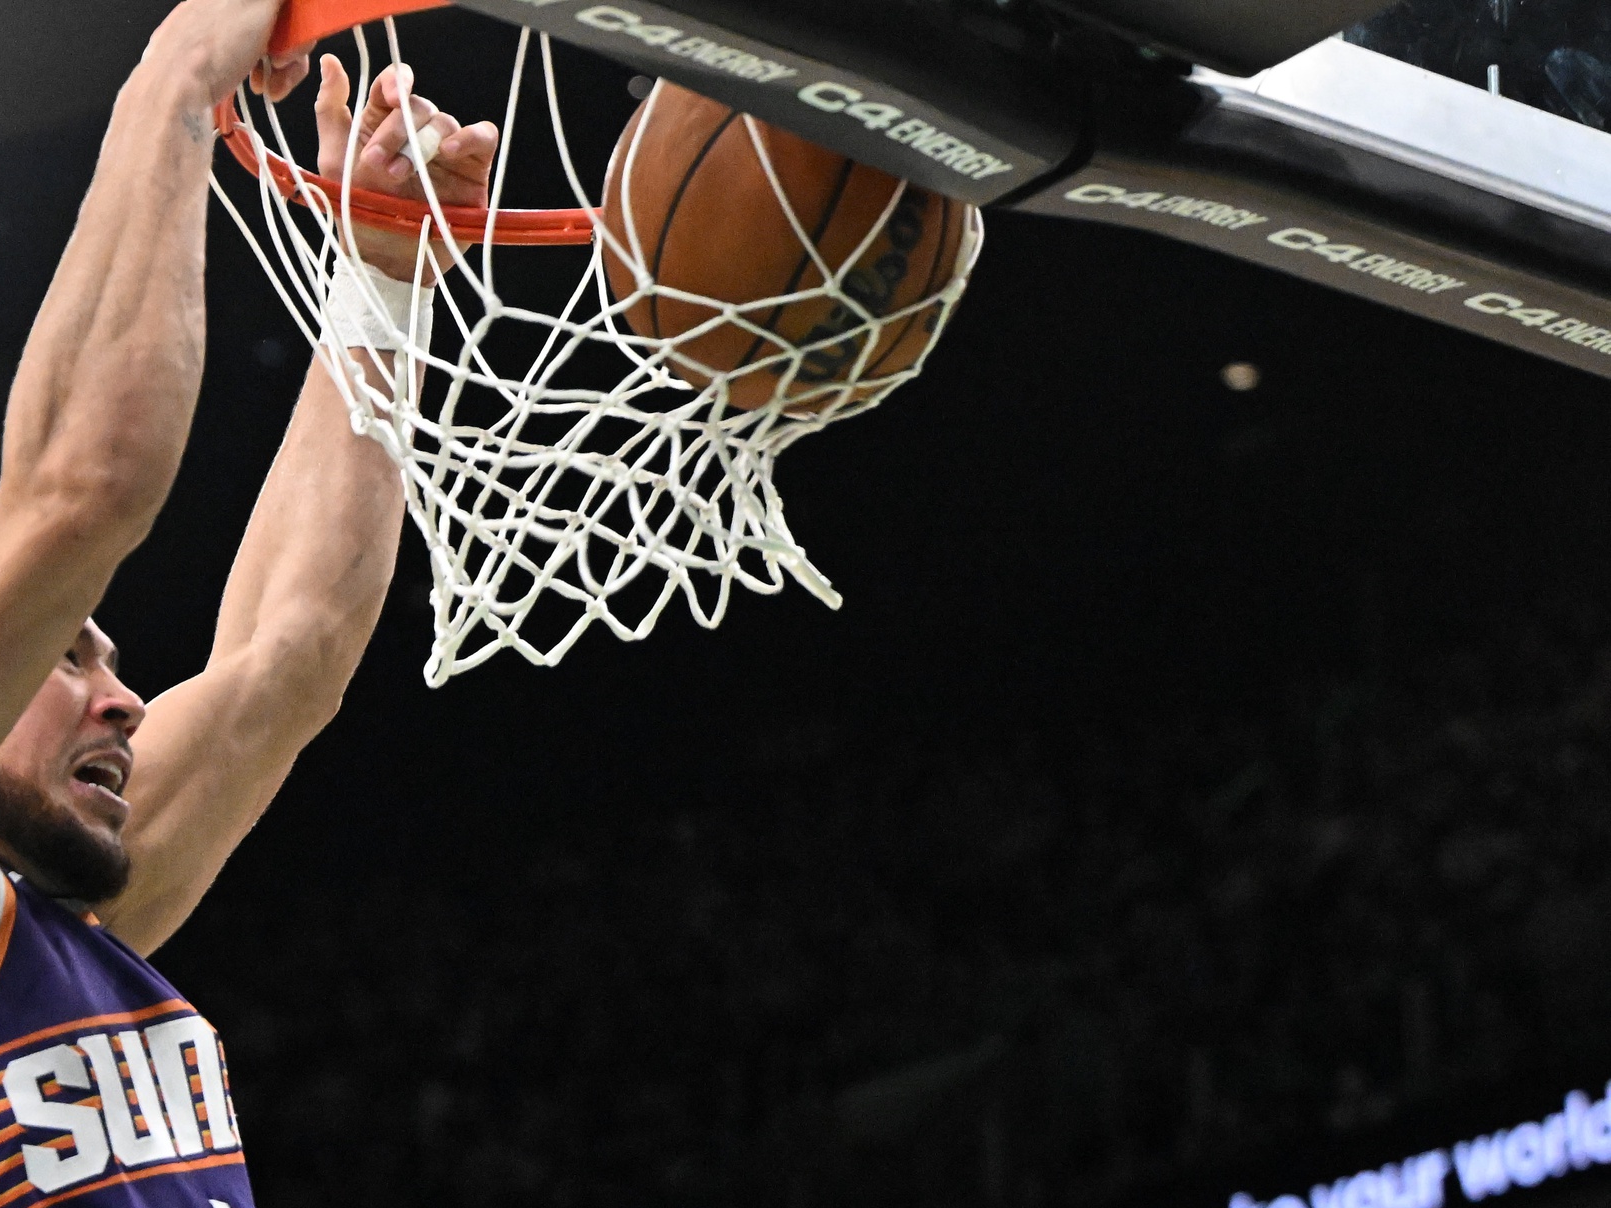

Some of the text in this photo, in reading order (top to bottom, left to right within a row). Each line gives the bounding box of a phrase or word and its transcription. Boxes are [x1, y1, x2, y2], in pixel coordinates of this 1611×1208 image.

[575, 5, 685, 46] C4
[797, 81, 1015, 180] C4 ENERGY
[1267, 227, 1466, 294] C4 ENERGY
[1463, 292, 1611, 355] C4 ENER
[2, 1015, 241, 1194] SUN
